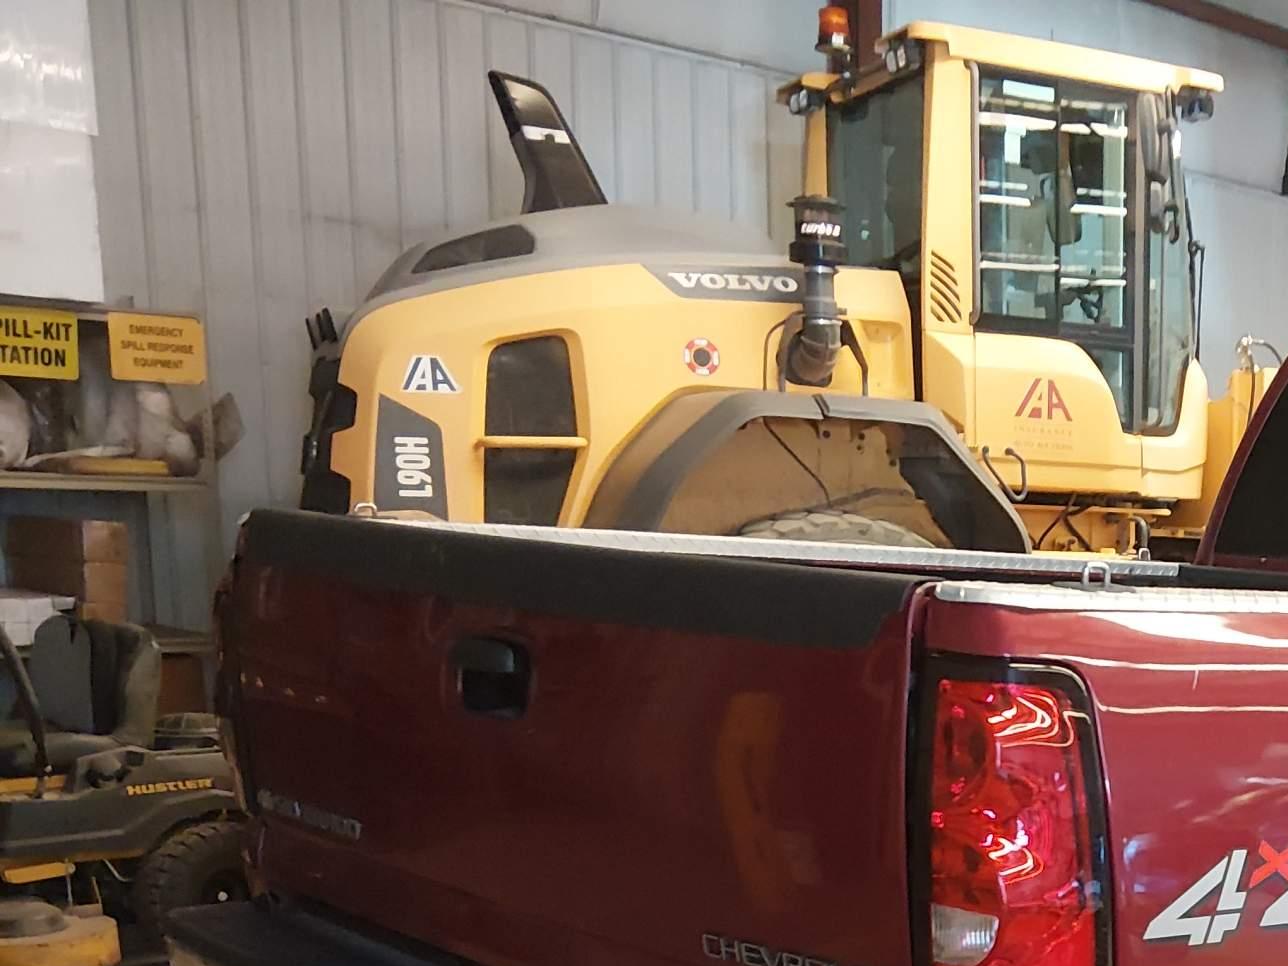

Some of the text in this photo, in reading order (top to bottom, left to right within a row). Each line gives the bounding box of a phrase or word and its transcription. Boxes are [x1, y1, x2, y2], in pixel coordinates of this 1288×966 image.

[668, 271, 799, 293] VOLVO
[0, 318, 73, 341] ILL-KIT
[129, 324, 184, 337] EMERGENCY
[120, 339, 194, 355] SPILL RESPONSE
[133, 356, 183, 369] EQUIPMENT
[393, 436, 434, 498] L90H
[126, 778, 216, 796] HUSTLER
